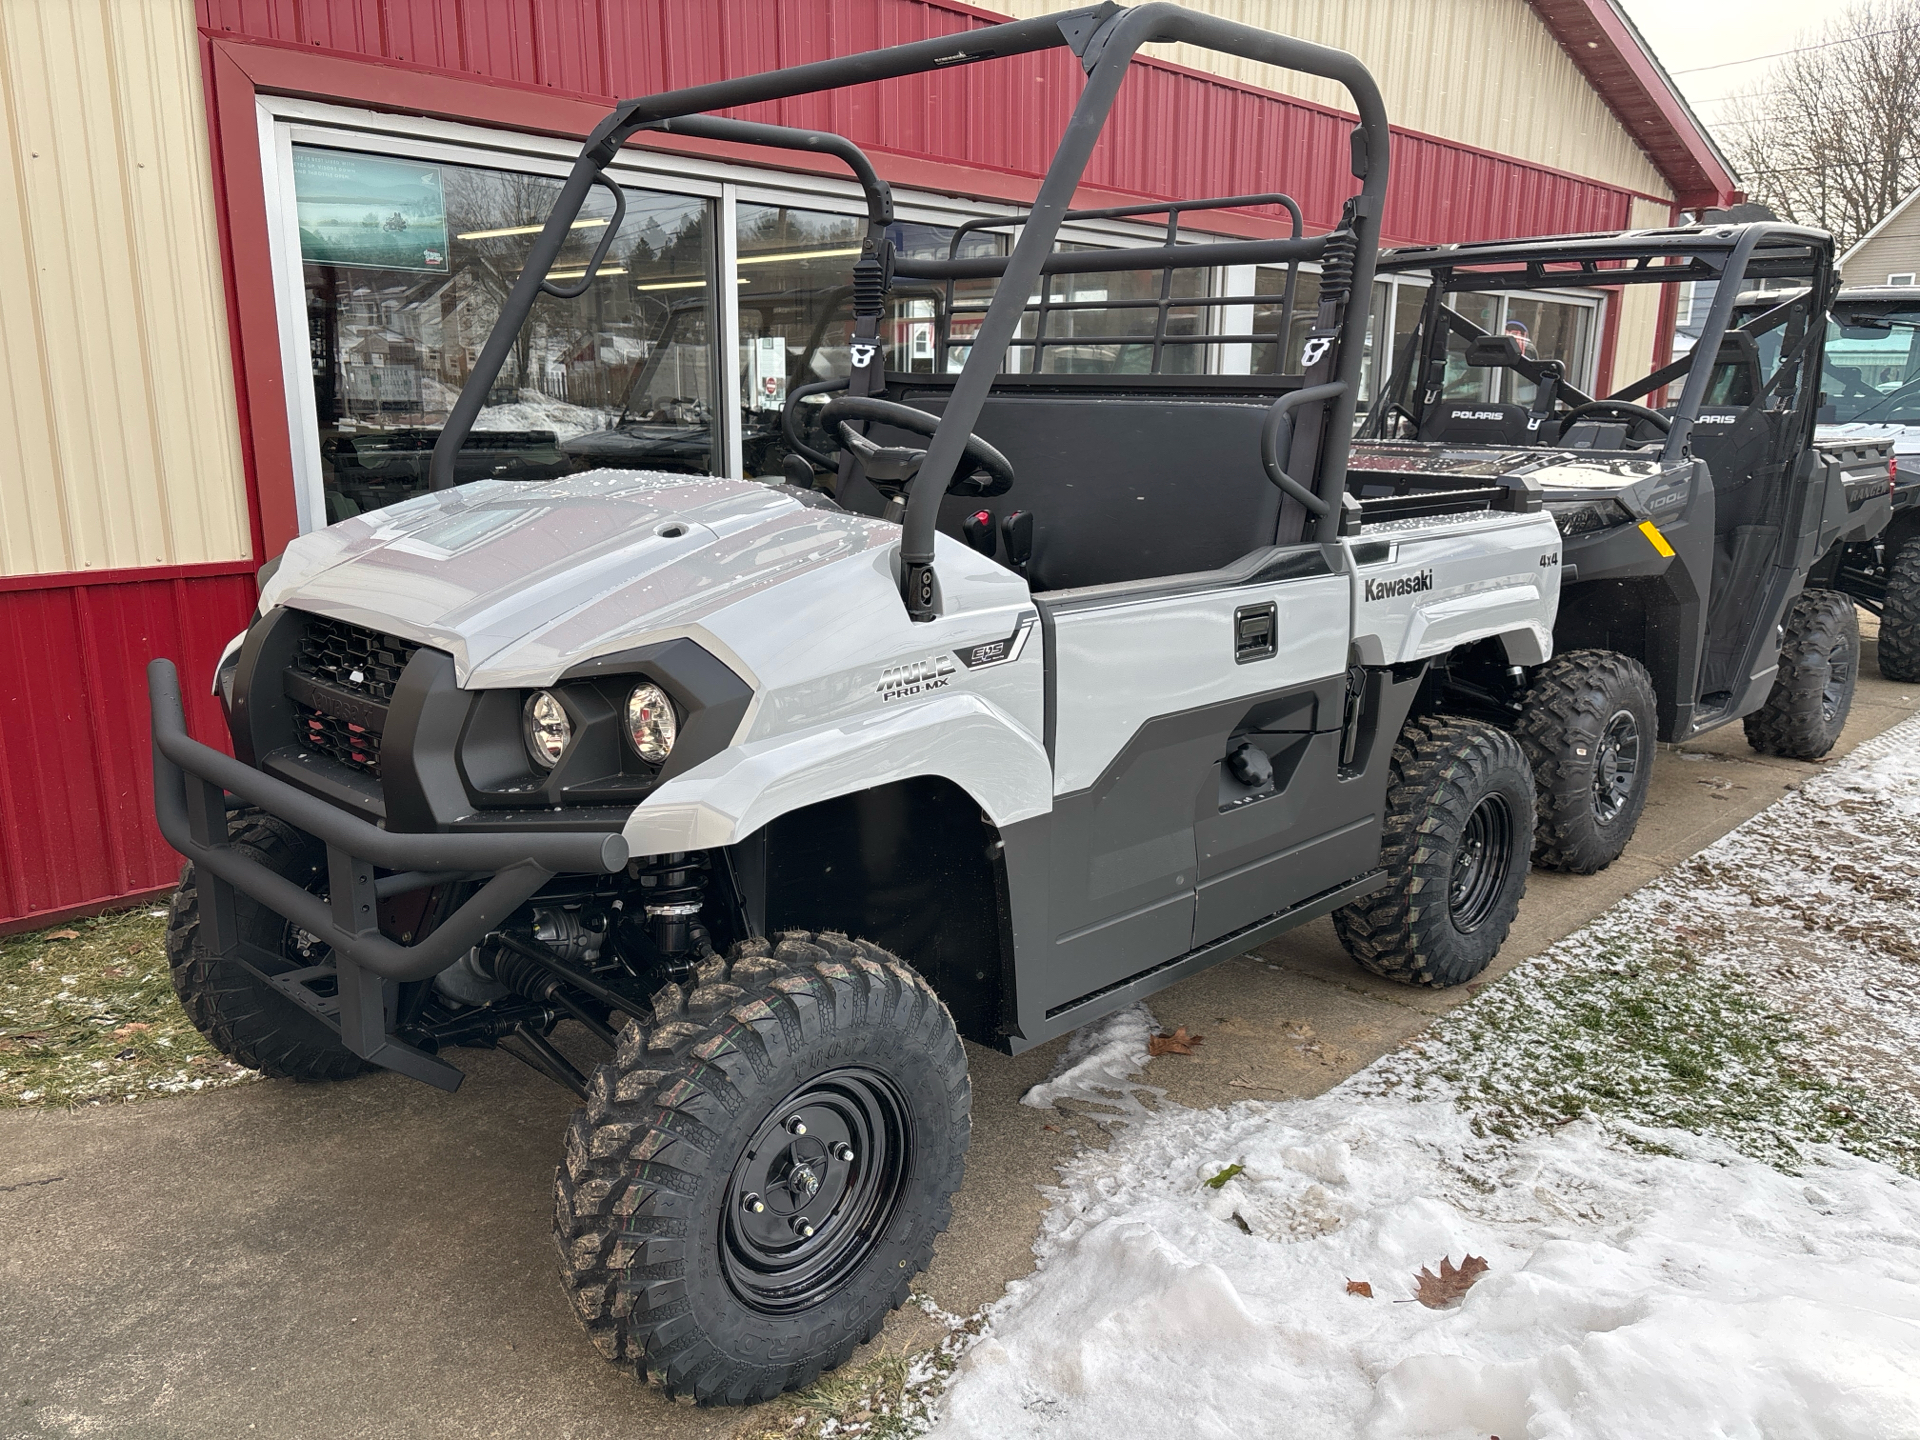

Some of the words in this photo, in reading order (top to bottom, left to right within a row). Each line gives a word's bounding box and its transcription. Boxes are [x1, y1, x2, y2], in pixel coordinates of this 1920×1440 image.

[1451, 410, 1504, 421] POLARIS
[1539, 552, 1559, 568] 4x4
[1364, 568, 1433, 602] Kawasaki
[971, 642, 1004, 661] EPS
[875, 655, 956, 693] MULE
